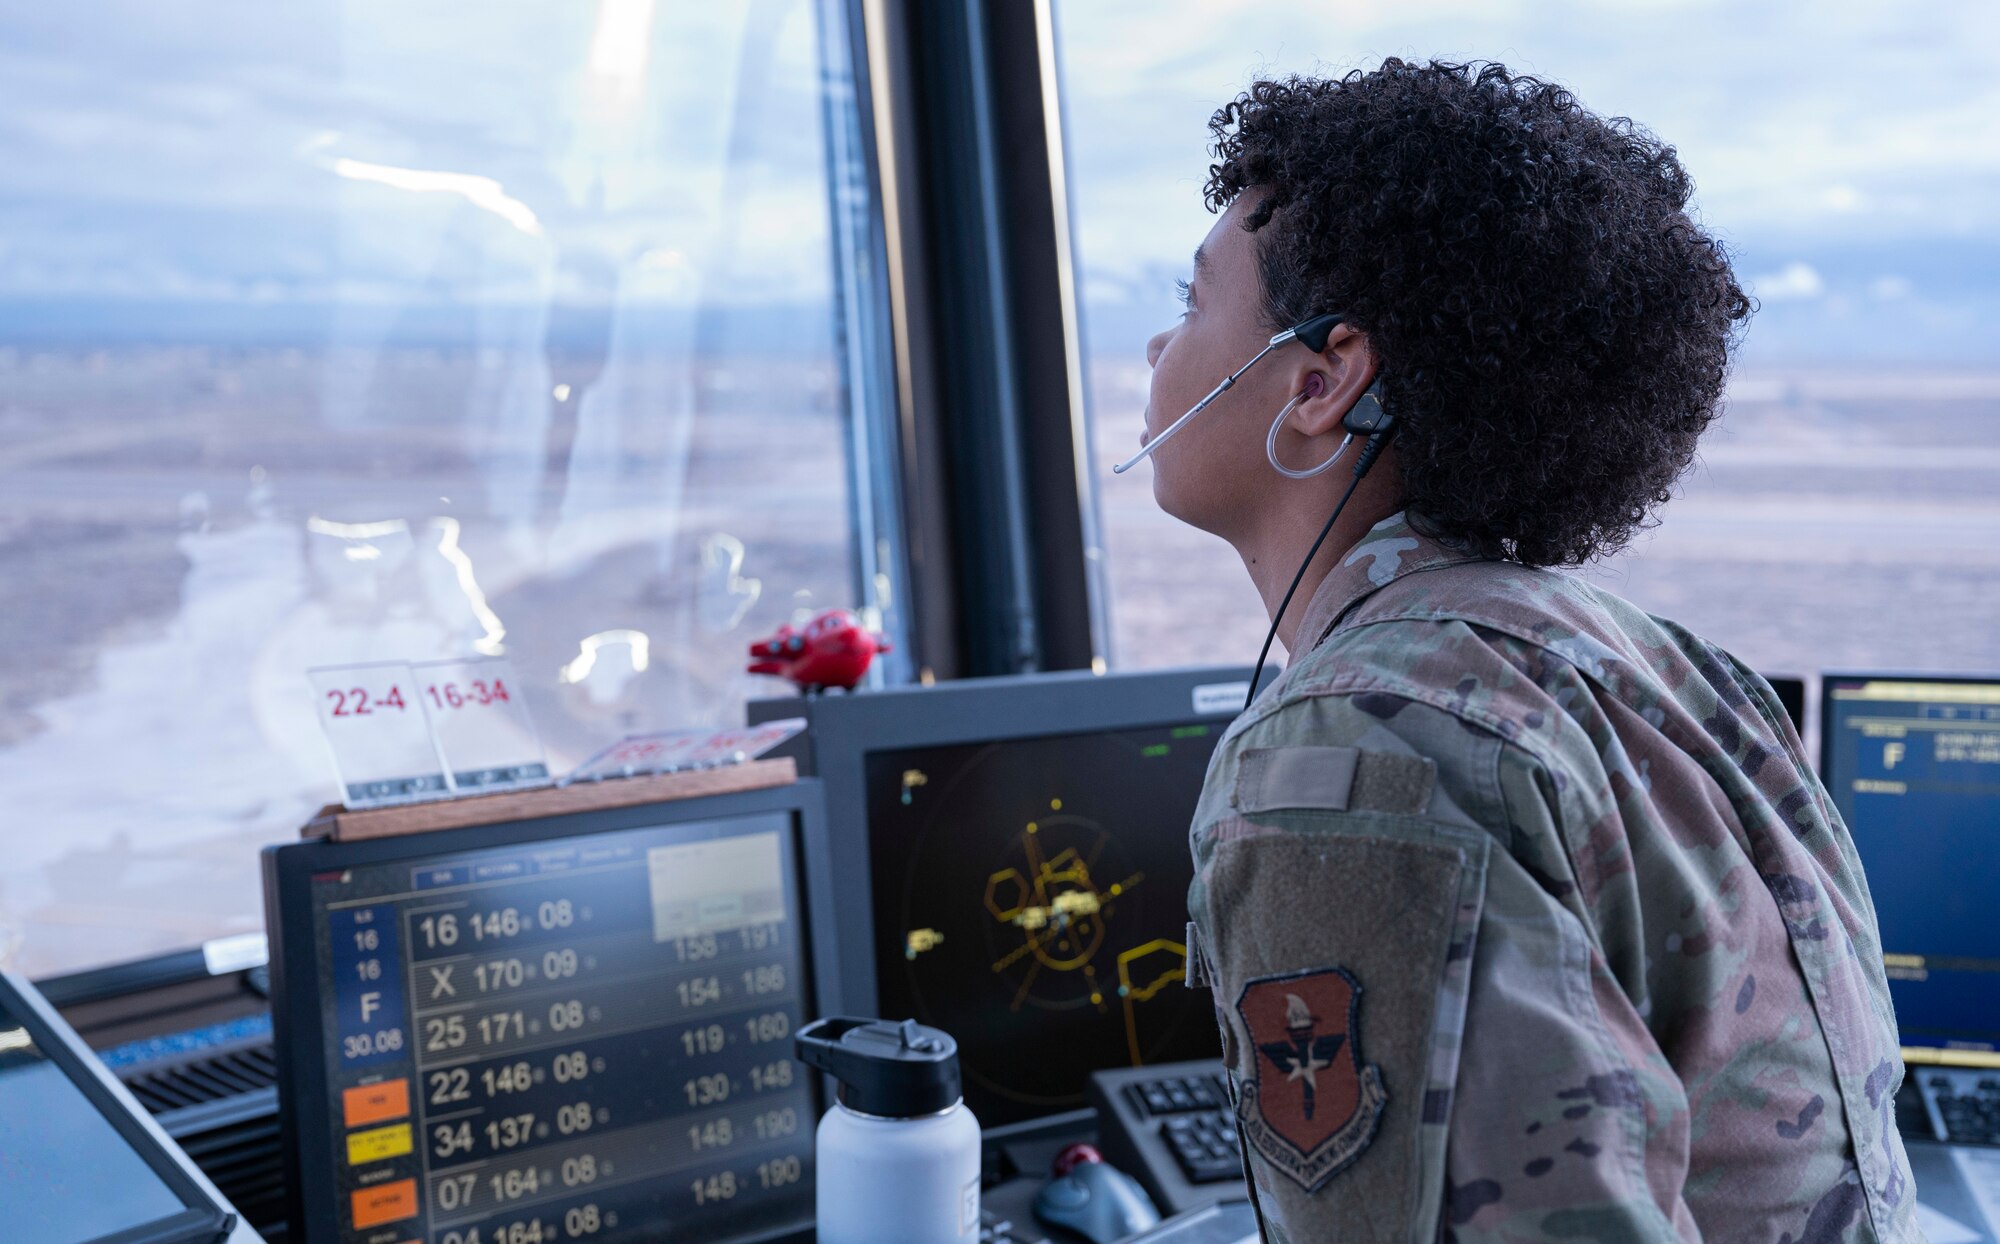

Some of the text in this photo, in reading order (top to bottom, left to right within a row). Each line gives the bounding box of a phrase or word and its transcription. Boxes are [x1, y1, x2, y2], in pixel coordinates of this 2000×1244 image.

[326, 684, 407, 718] 22-4
[427, 677, 511, 709] 16-34
[353, 929, 380, 951] 16
[420, 913, 459, 948] 16
[469, 907, 520, 941] 146
[539, 899, 574, 930] 08
[355, 958, 382, 981] 16
[430, 964, 456, 999] X
[473, 958, 524, 992] 170
[542, 948, 578, 980] 09
[360, 991, 382, 1023] F
[425, 1015, 467, 1052] 25
[476, 1009, 525, 1045] 171
[549, 999, 585, 1032] 08
[676, 976, 720, 1008] 154
[429, 1067, 472, 1105] 22
[480, 1061, 532, 1097] 146
[553, 1050, 589, 1083] 08
[681, 1023, 725, 1057] 119
[433, 1120, 475, 1158] 34
[484, 1112, 535, 1150] 137
[557, 1101, 593, 1135] 08
[683, 1072, 730, 1107] 130
[437, 1173, 478, 1211] 07
[489, 1165, 539, 1202] 164
[561, 1153, 597, 1187] 08
[564, 1203, 601, 1237] 08
[691, 1170, 738, 1206] 148
